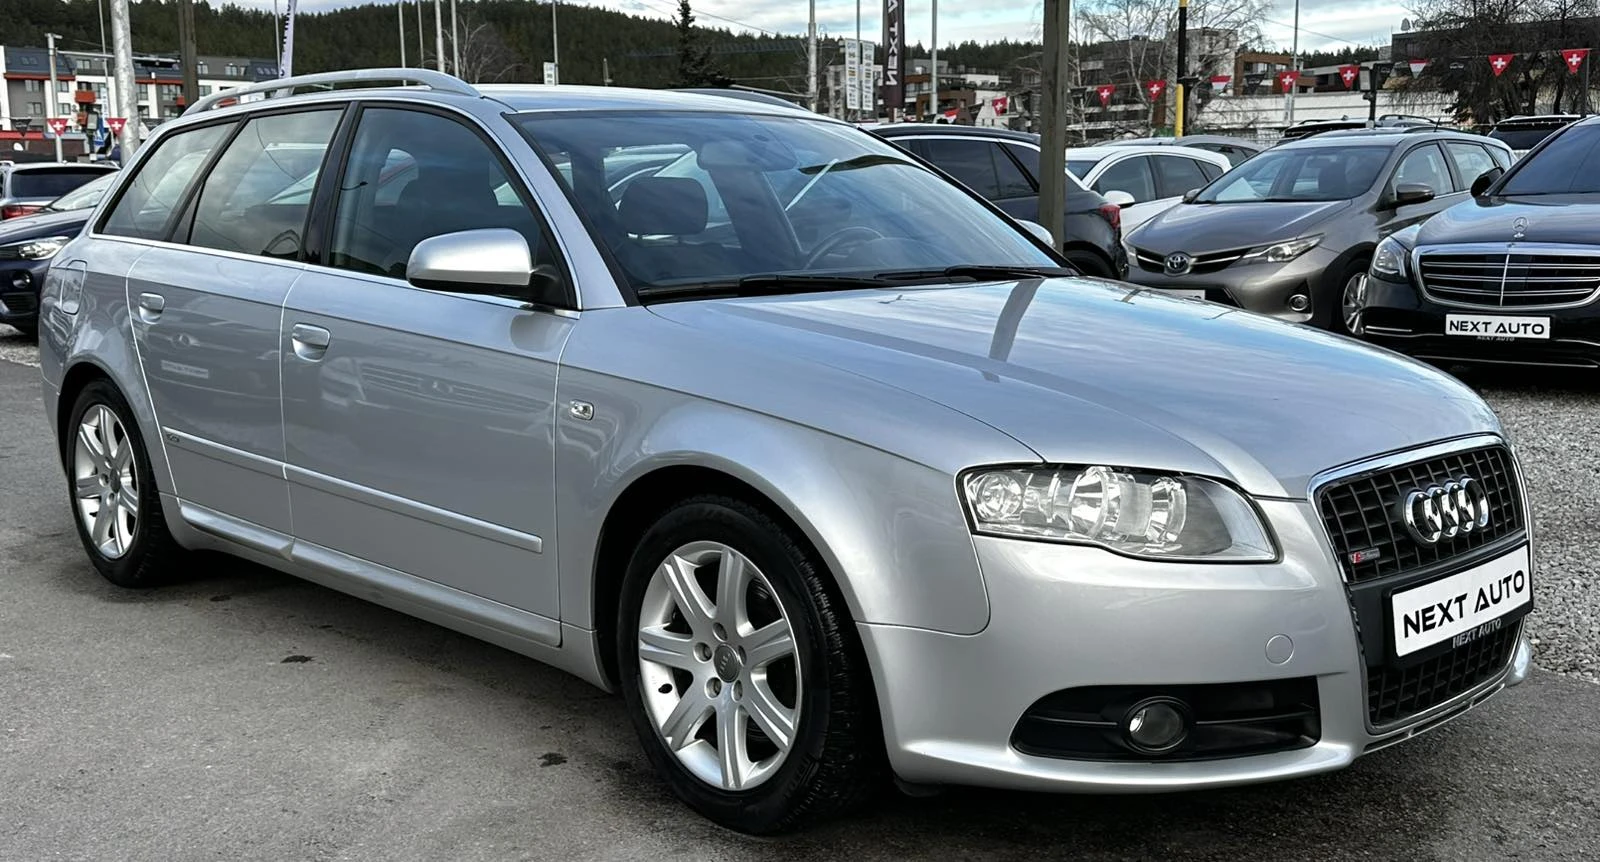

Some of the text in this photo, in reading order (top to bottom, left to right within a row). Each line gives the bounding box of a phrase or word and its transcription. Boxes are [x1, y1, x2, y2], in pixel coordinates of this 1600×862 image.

[1449, 320, 1545, 335] NEXT AUTO
[1403, 569, 1525, 639] NEXT AUTO
[1452, 617, 1502, 649] NEXT AUTO
